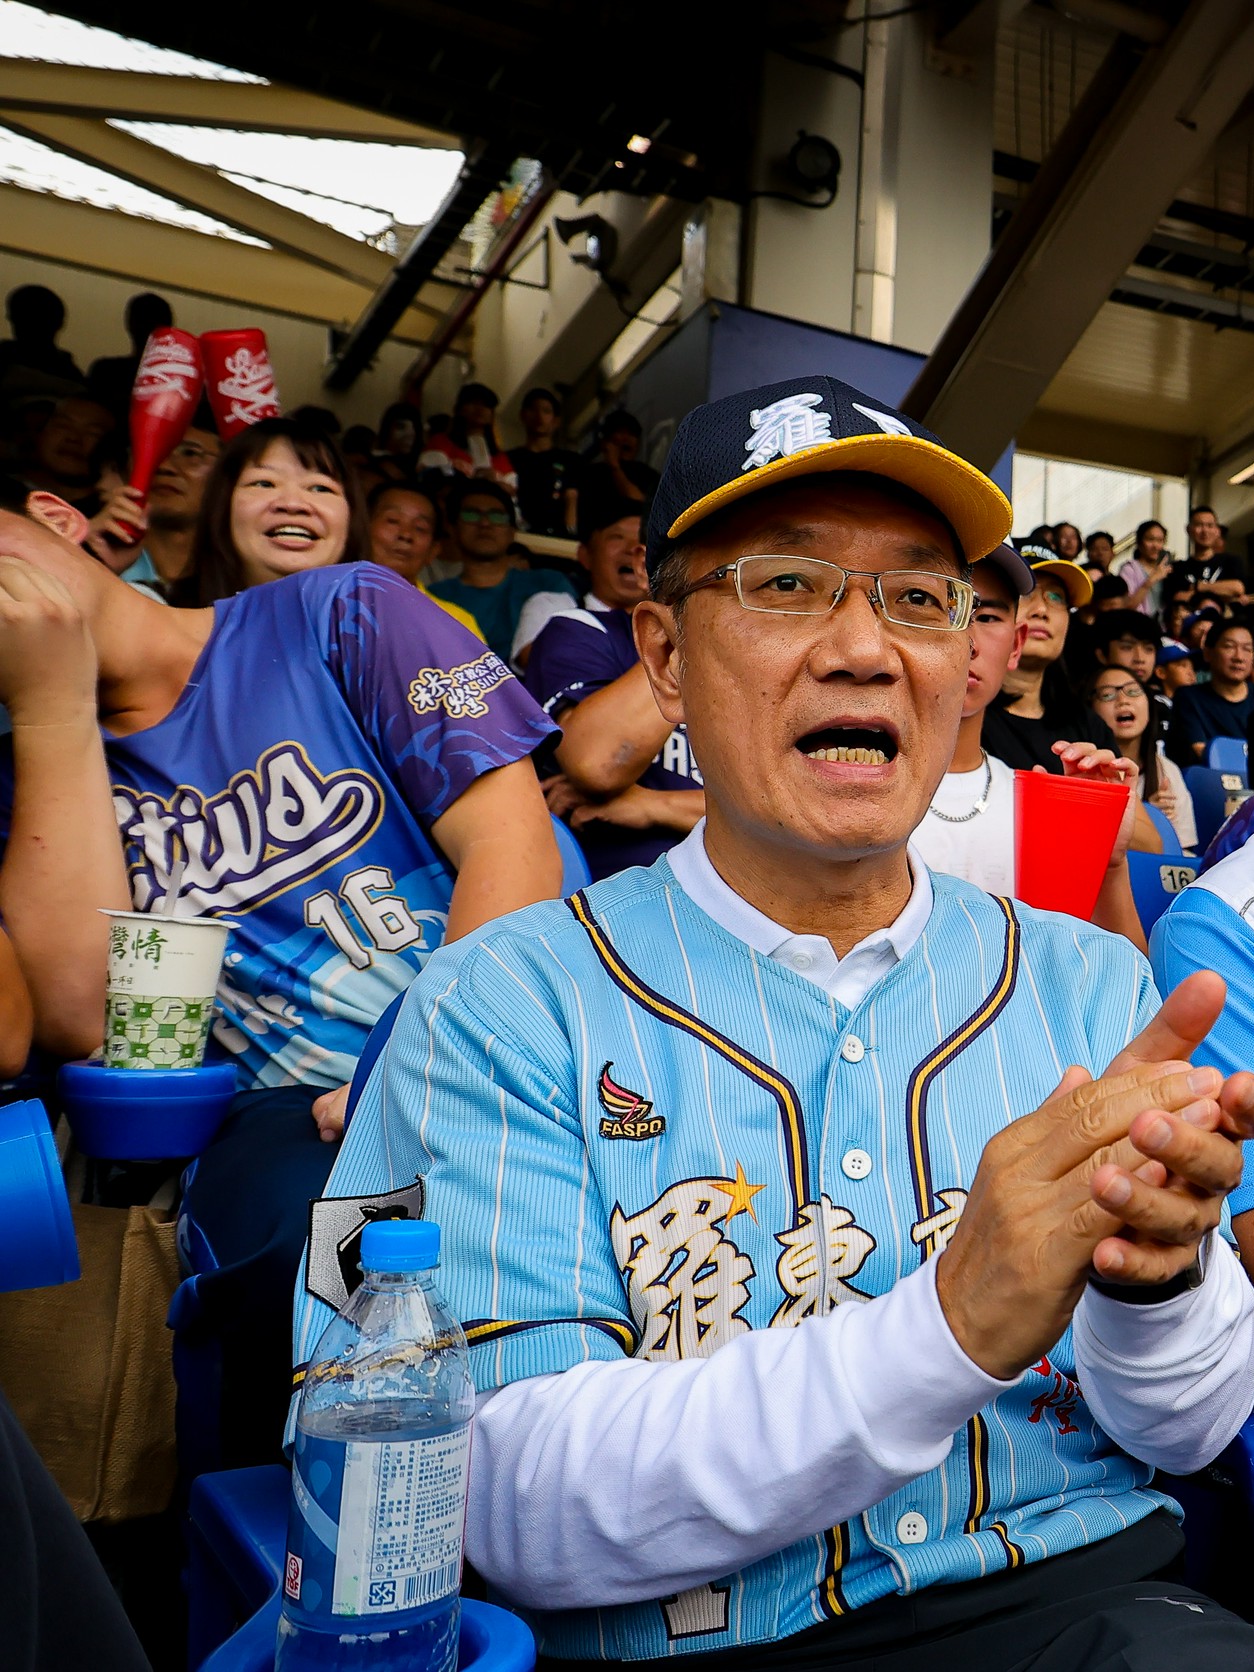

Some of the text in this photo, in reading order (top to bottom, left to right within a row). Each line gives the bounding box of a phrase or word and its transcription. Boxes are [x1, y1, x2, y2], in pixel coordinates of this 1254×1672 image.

[1167, 869, 1190, 891] 16
[306, 869, 423, 971] 16
[602, 1120, 662, 1137] FASPO
